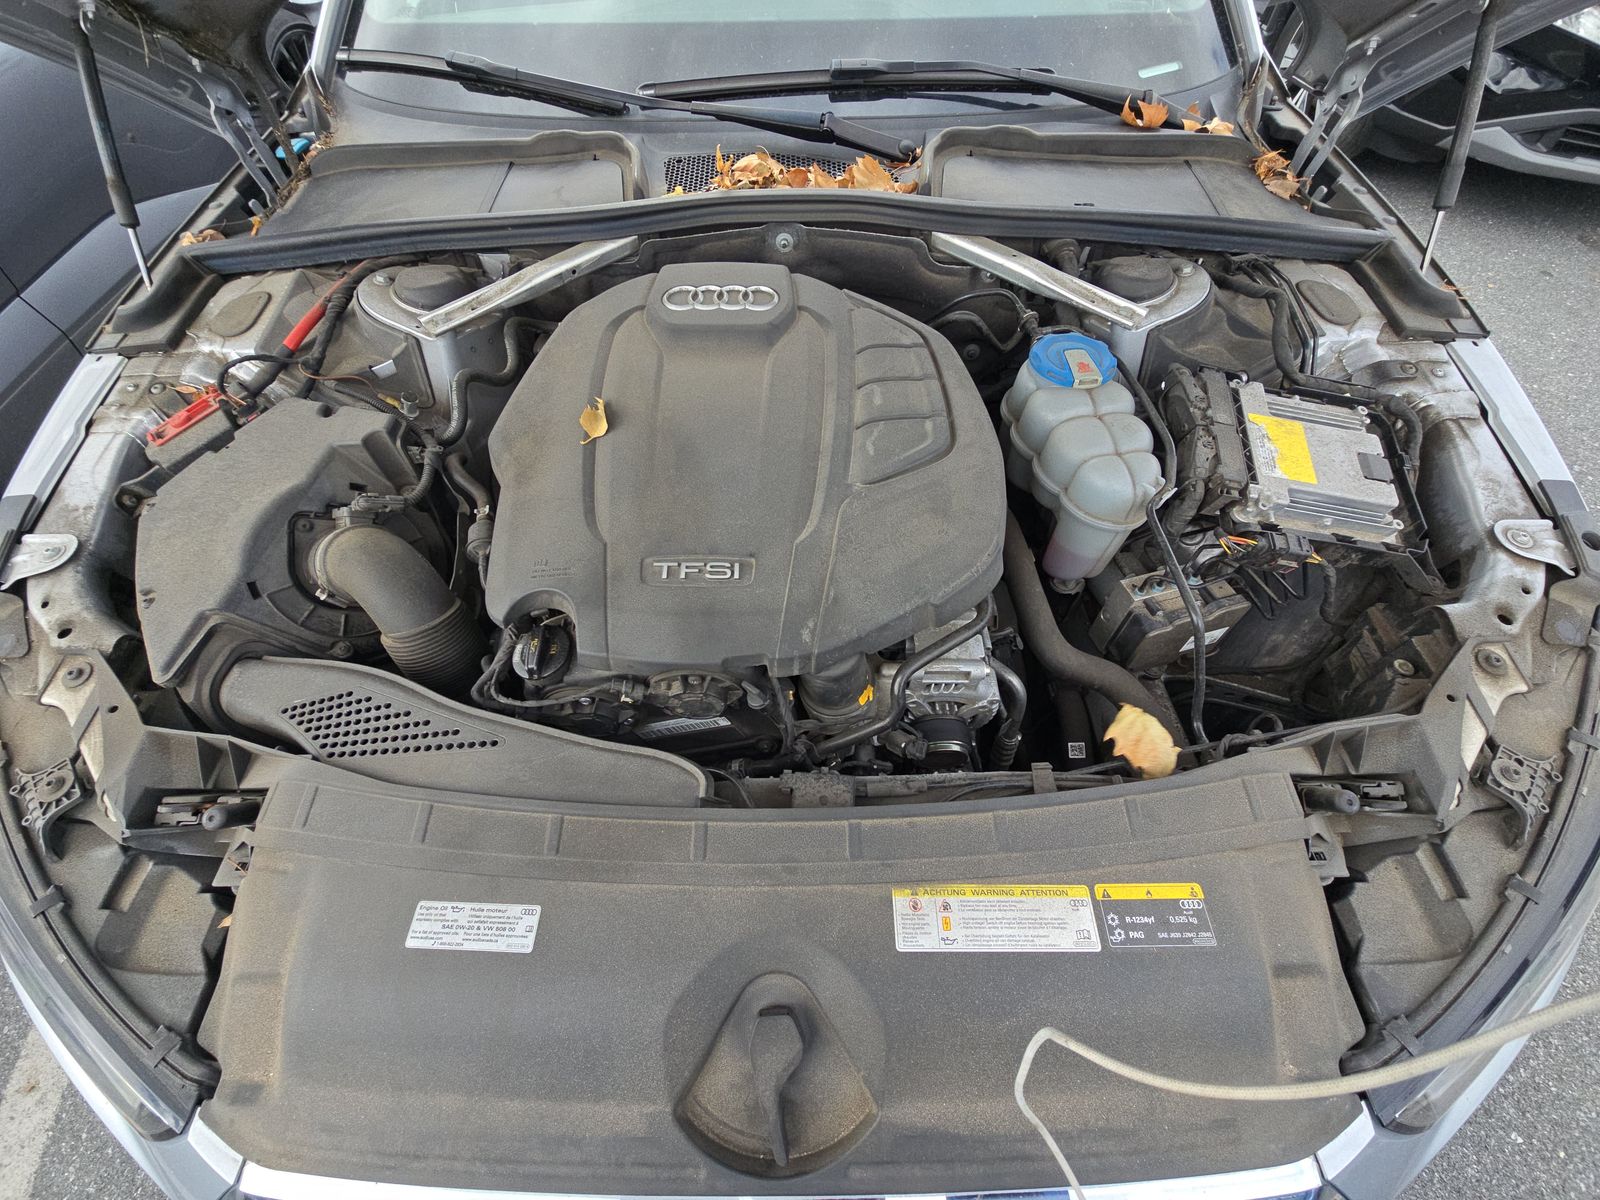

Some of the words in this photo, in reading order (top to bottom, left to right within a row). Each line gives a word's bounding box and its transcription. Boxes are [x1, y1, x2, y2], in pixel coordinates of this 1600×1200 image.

[653, 561, 741, 580] TFSI
[923, 888, 967, 897] ACHTUNG
[970, 888, 1016, 897] WARNING
[1019, 888, 1069, 897] ATTENTION
[1125, 915, 1155, 925] R-1234yf
[1189, 916, 1198, 924] kg
[1129, 931, 1145, 939] PAG
